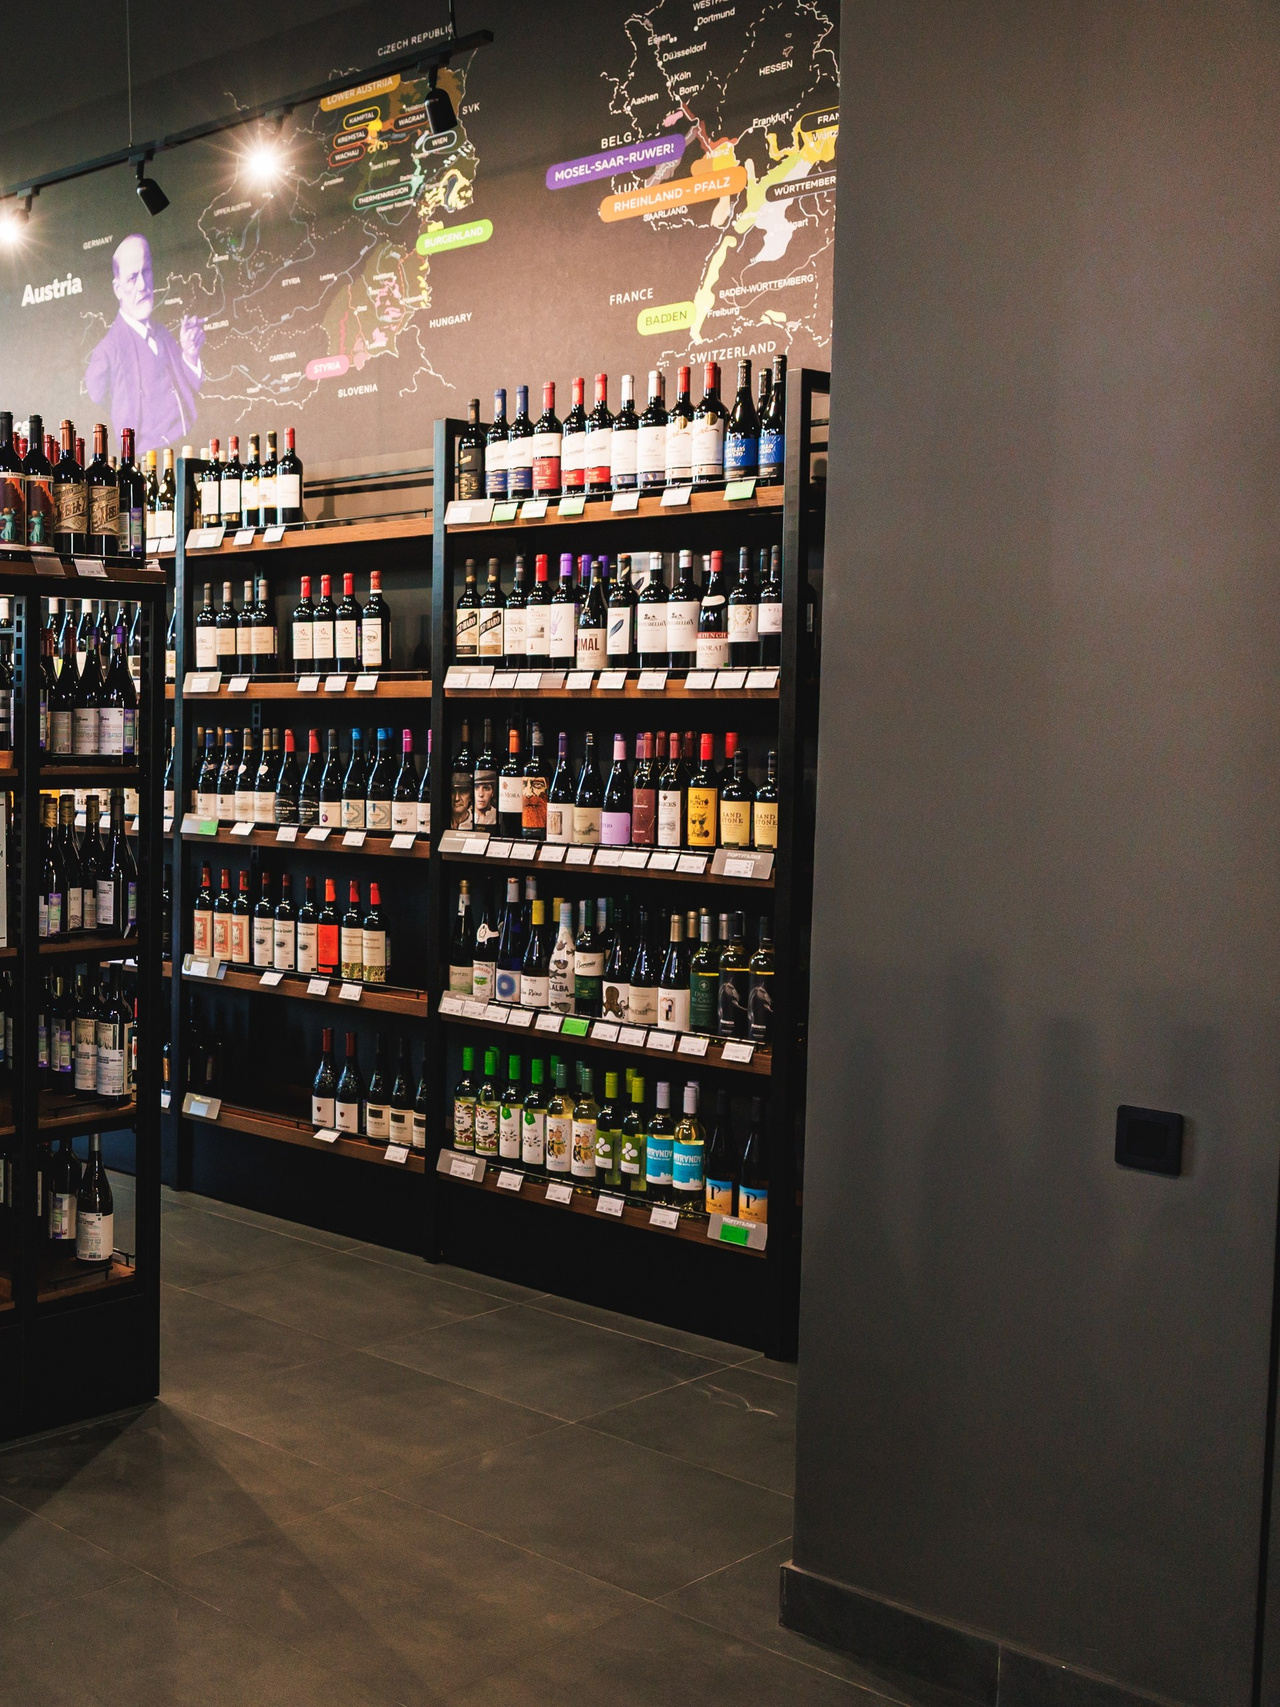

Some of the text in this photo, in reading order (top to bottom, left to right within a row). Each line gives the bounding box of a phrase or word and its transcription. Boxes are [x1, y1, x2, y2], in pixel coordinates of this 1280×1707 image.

[697, 7, 736, 26] Dortmund
[377, 25, 453, 57] CZECH REPUBLIC
[647, 33, 671, 46] Essen
[759, 60, 794, 76] HESSEN
[673, 71, 692, 83] Köln
[326, 87, 355, 106] LOWER
[679, 83, 699, 96] Bonn
[630, 92, 659, 106] Aachen
[462, 102, 480, 115] SVK
[398, 112, 426, 126] WAGRAM
[752, 111, 791, 127] Frankfurt
[431, 136, 448, 146] WIEN
[601, 130, 635, 149] BELG.
[334, 148, 360, 161] WACHAU
[706, 148, 730, 160] Mainz
[613, 187, 683, 213] RHEINLAND
[694, 176, 731, 195] PFALZ
[82, 235, 114, 250] GERMANY
[424, 226, 484, 249] BURGENLAND
[21, 272, 83, 307] Austria
[719, 273, 815, 299] BADEN-WÜRTTEMBERG
[609, 287, 654, 306] FRANCE
[645, 309, 688, 327] BADEN
[706, 305, 741, 318] Freiburg
[429, 311, 473, 329] HUNGARY
[689, 340, 777, 365] SWITZERLAND
[313, 360, 341, 374] STYRIA
[337, 383, 379, 398] SLOVENIA
